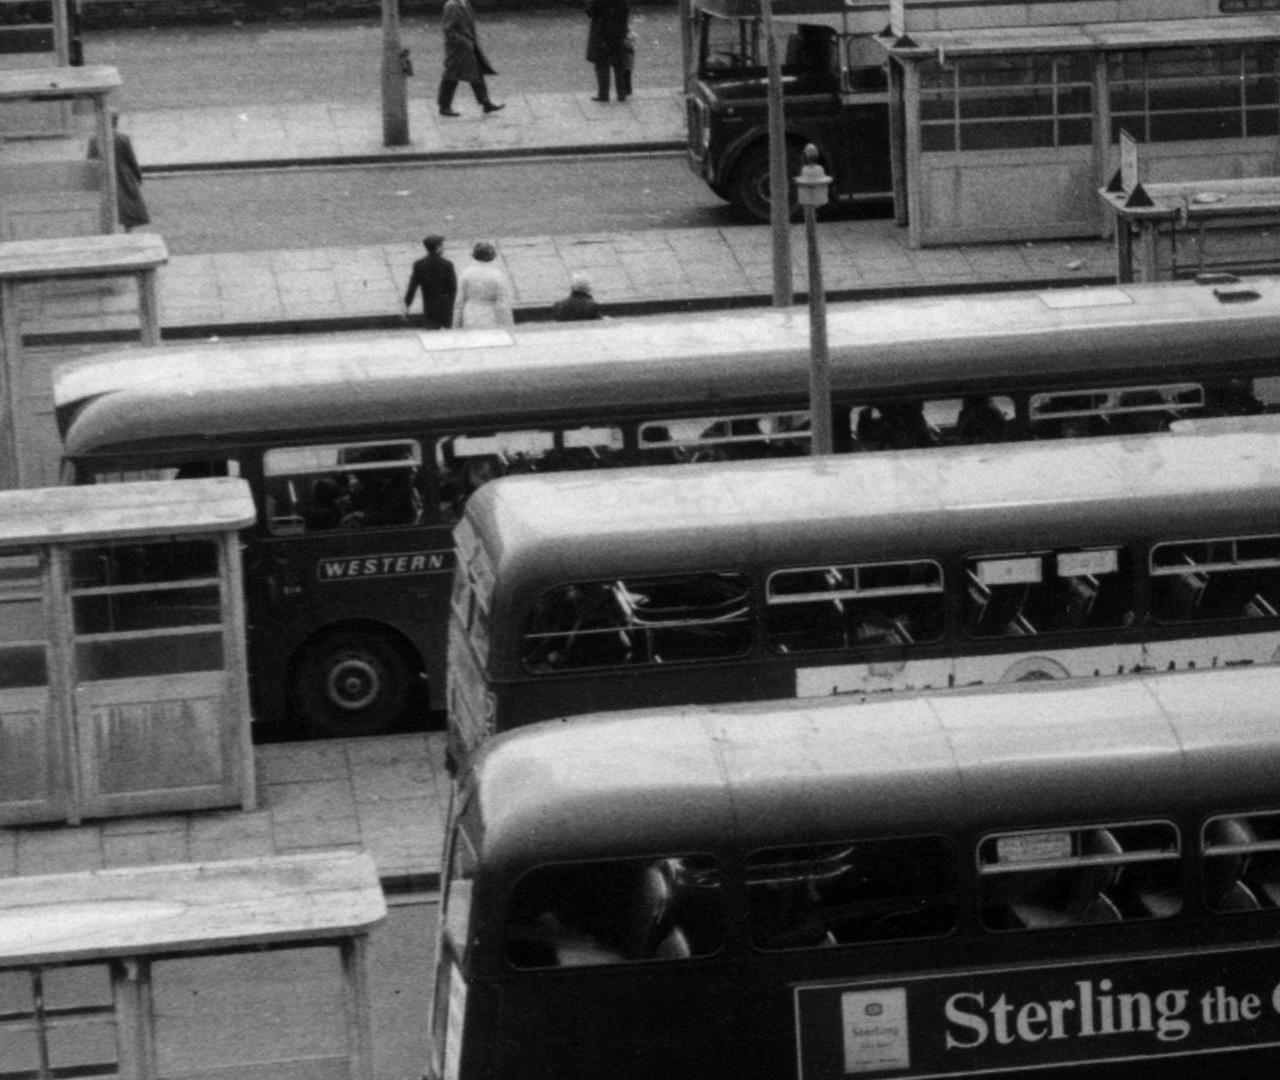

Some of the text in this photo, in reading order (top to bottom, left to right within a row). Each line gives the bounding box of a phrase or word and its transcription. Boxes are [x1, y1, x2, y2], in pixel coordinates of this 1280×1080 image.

[325, 555, 445, 577] WESTERN
[944, 979, 1191, 1051] Sterling
[1201, 986, 1262, 1024] the
